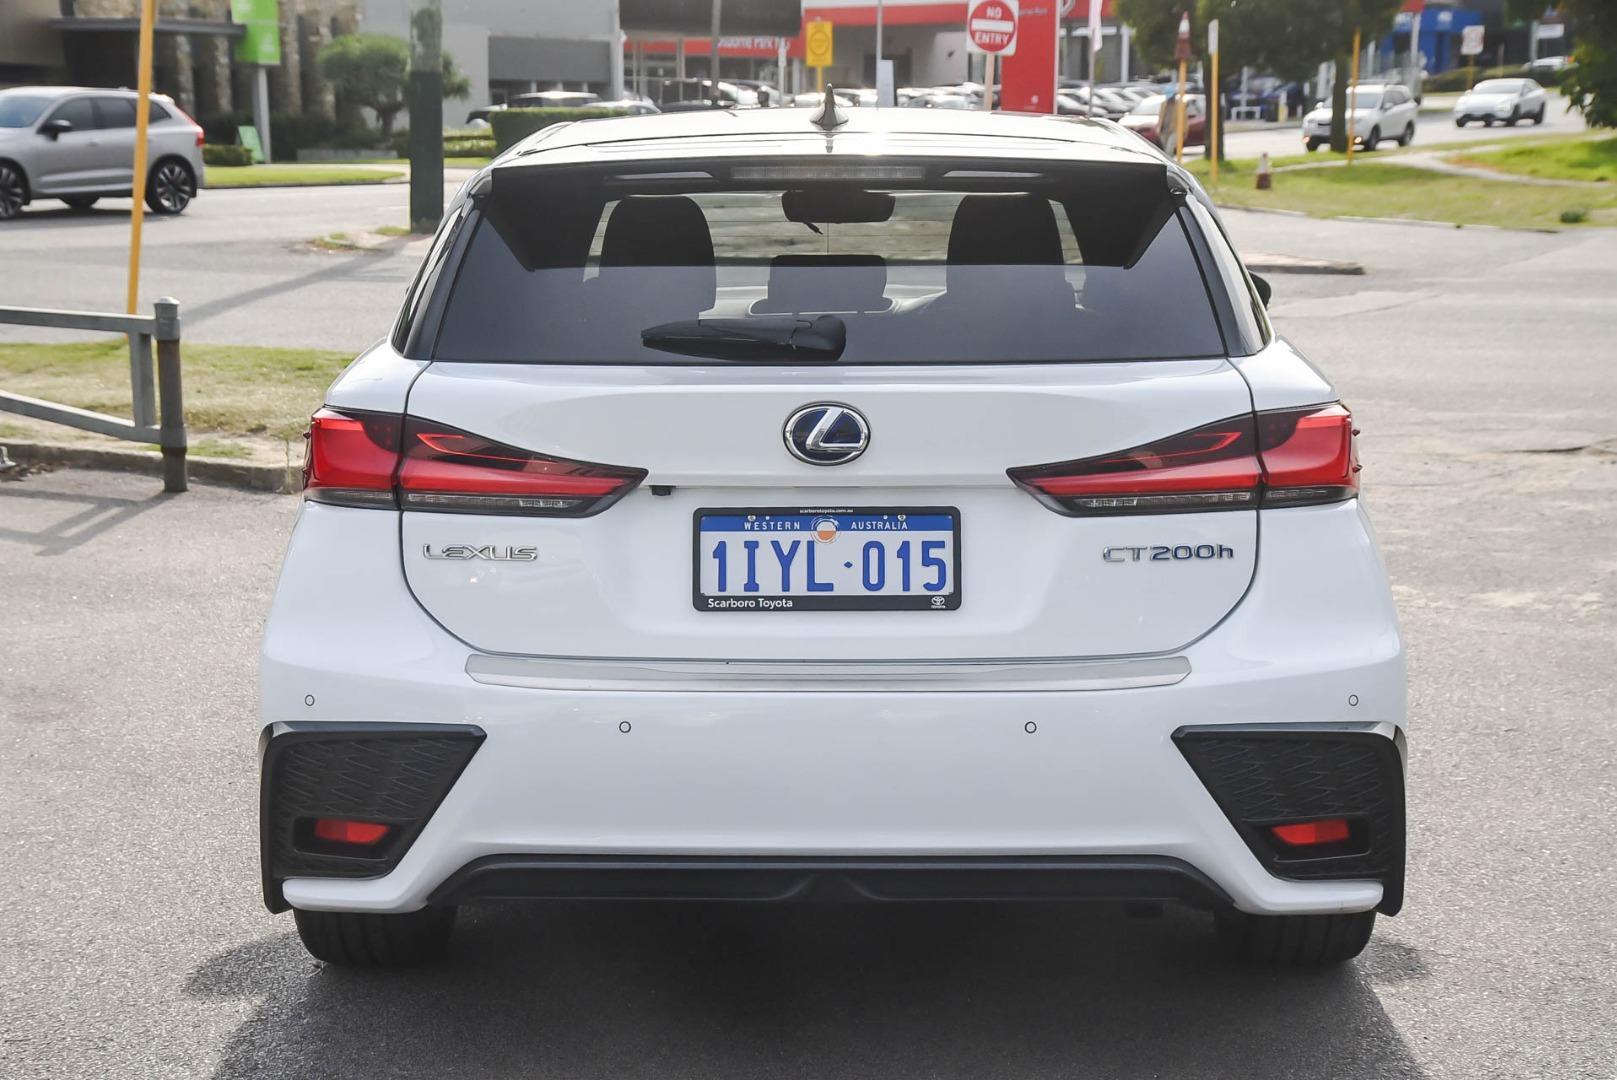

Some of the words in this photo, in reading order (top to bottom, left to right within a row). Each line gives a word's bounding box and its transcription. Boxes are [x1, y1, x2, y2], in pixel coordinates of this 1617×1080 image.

[986, 6, 1002, 19] NO
[974, 32, 1010, 46] ENTRY
[744, 521, 800, 530] WESTERN
[850, 521, 908, 530] AUSTRALIA
[422, 543, 538, 561] LEXUS
[1102, 544, 1234, 562] CT200h
[707, 598, 756, 608] Scarboro
[757, 598, 794, 610] Toyota
